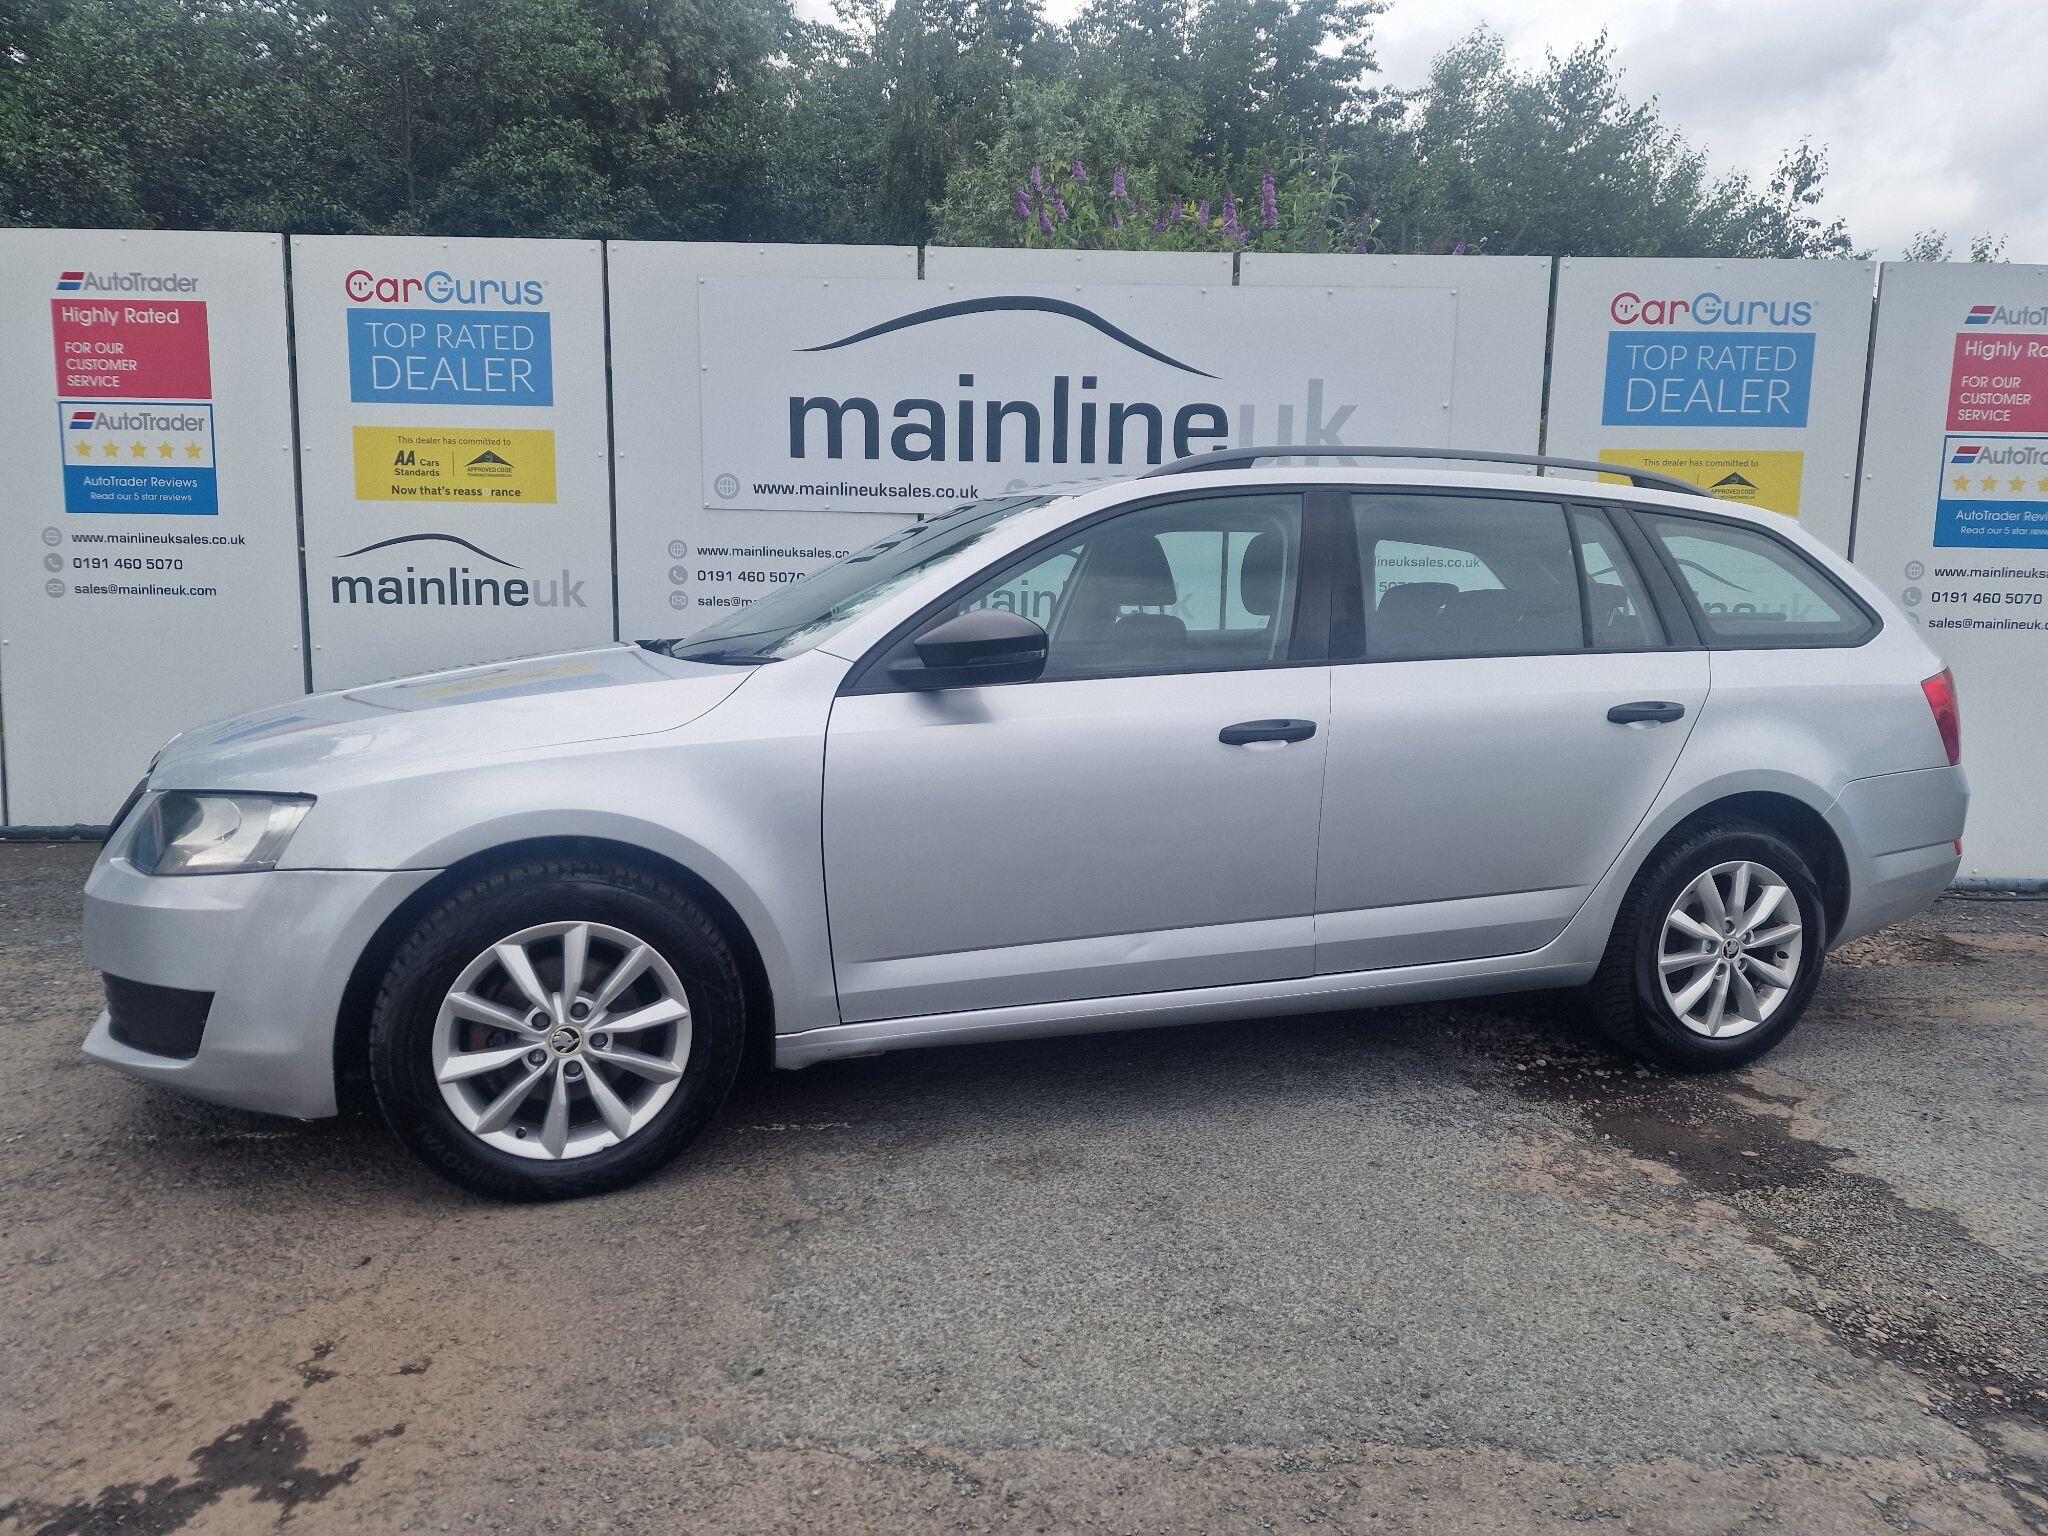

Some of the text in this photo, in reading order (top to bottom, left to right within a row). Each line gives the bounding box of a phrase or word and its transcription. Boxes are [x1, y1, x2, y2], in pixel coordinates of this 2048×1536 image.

[83, 272, 199, 292] AutoTrader
[345, 270, 544, 305] CarGurus
[1611, 292, 1811, 326] CarGurus
[62, 307, 180, 326] Highly Rated
[364, 322, 534, 350] TOP RATED
[64, 342, 124, 354] FOR OUR
[1964, 340, 2022, 360] Highly
[66, 358, 138, 371] CUSTOMER
[1625, 345, 1796, 371] TOP RATED
[372, 355, 535, 392] DEALER
[66, 375, 121, 388] SERVICE
[1962, 376, 2021, 388] FOR OUR
[1626, 378, 1790, 414] DEALER
[1960, 392, 2032, 405] CUSTOMER
[1957, 409, 2012, 421] SERVICE
[94, 412, 205, 432] AutoTrader
[398, 436, 414, 444] This
[416, 437, 441, 445] dealer
[442, 437, 456, 445] has
[458, 438, 500, 446] committed
[394, 450, 440, 467] AA Cars
[1644, 459, 1660, 467] This
[1662, 459, 1688, 467] dealer
[1689, 459, 1703, 467] has
[394, 468, 440, 477] Standards
[83, 476, 198, 488] AutoTrader Reviews
[391, 485, 417, 495] Now
[453, 488, 521, 497] reassrance
[753, 481, 979, 499] www.mainlineuksales.co.uk
[90, 492, 115, 501] Read
[142, 493, 157, 501] star
[160, 493, 192, 502] reviews
[1955, 510, 2020, 521] AutoTrader
[1960, 526, 1985, 535] Read
[2011, 527, 2028, 535] star
[72, 533, 246, 545] www.mainlineuksales.co.uk
[73, 557, 183, 570] 0191 460 5070
[697, 570, 732, 581] 0191
[738, 571, 765, 582] 460
[75, 584, 217, 596] sales@mainlineuk.com
[332, 567, 588, 608] mainlineuk
[1931, 591, 2043, 605] 0191 460 5070
